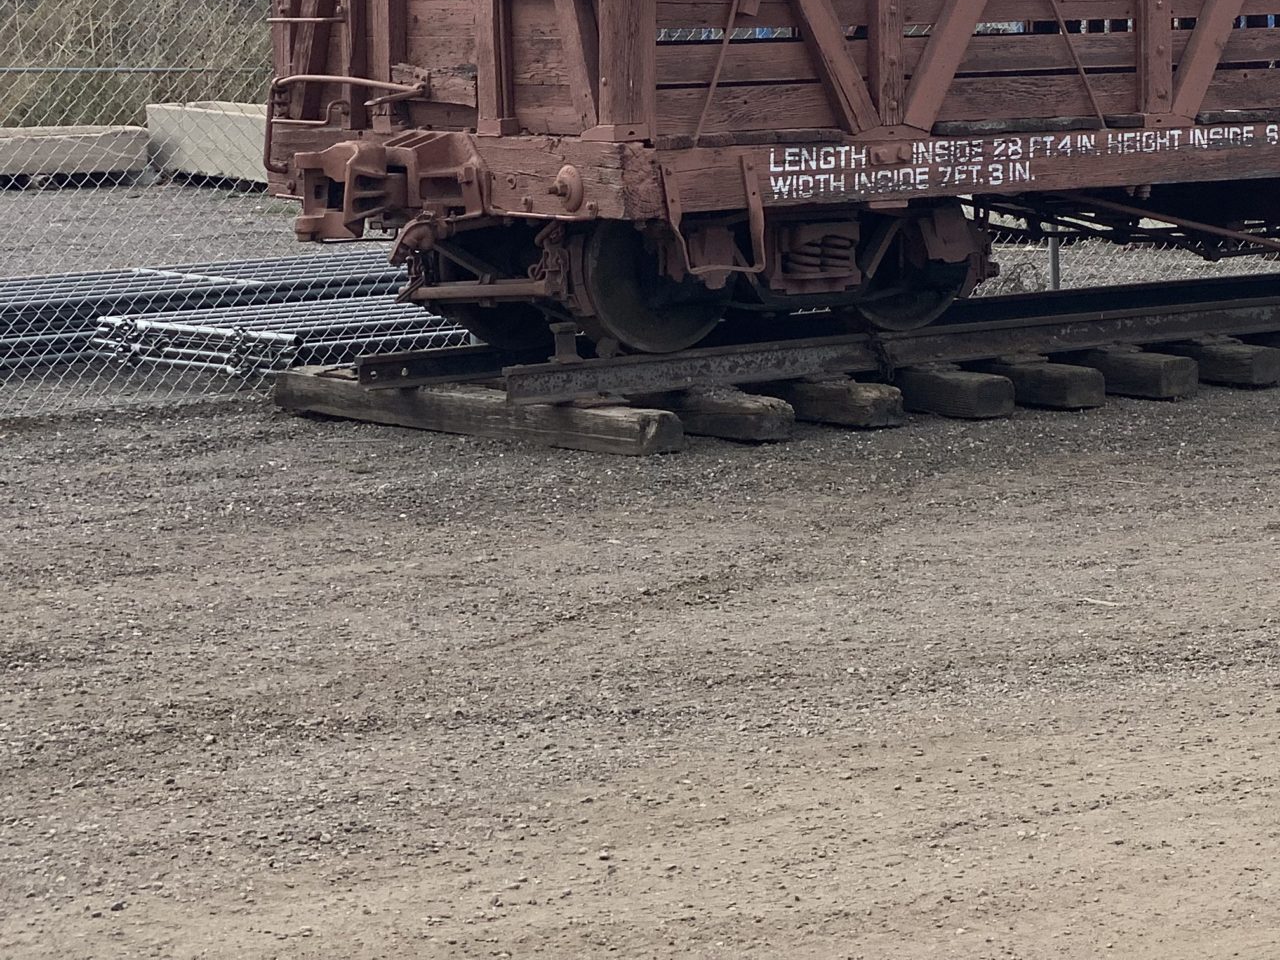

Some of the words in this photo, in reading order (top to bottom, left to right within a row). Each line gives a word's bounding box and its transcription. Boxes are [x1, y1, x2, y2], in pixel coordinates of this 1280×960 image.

[769, 145, 867, 172] LENGTH
[912, 140, 984, 164] INSIDE
[993, 137, 1023, 160] 28
[1108, 129, 1183, 154] HEIGHT
[1189, 125, 1255, 149] INSIDE
[770, 174, 845, 200] WIDTH
[855, 168, 929, 194] INSIDE
[988, 163, 1004, 185] 3
[1009, 161, 1036, 184] IN.
